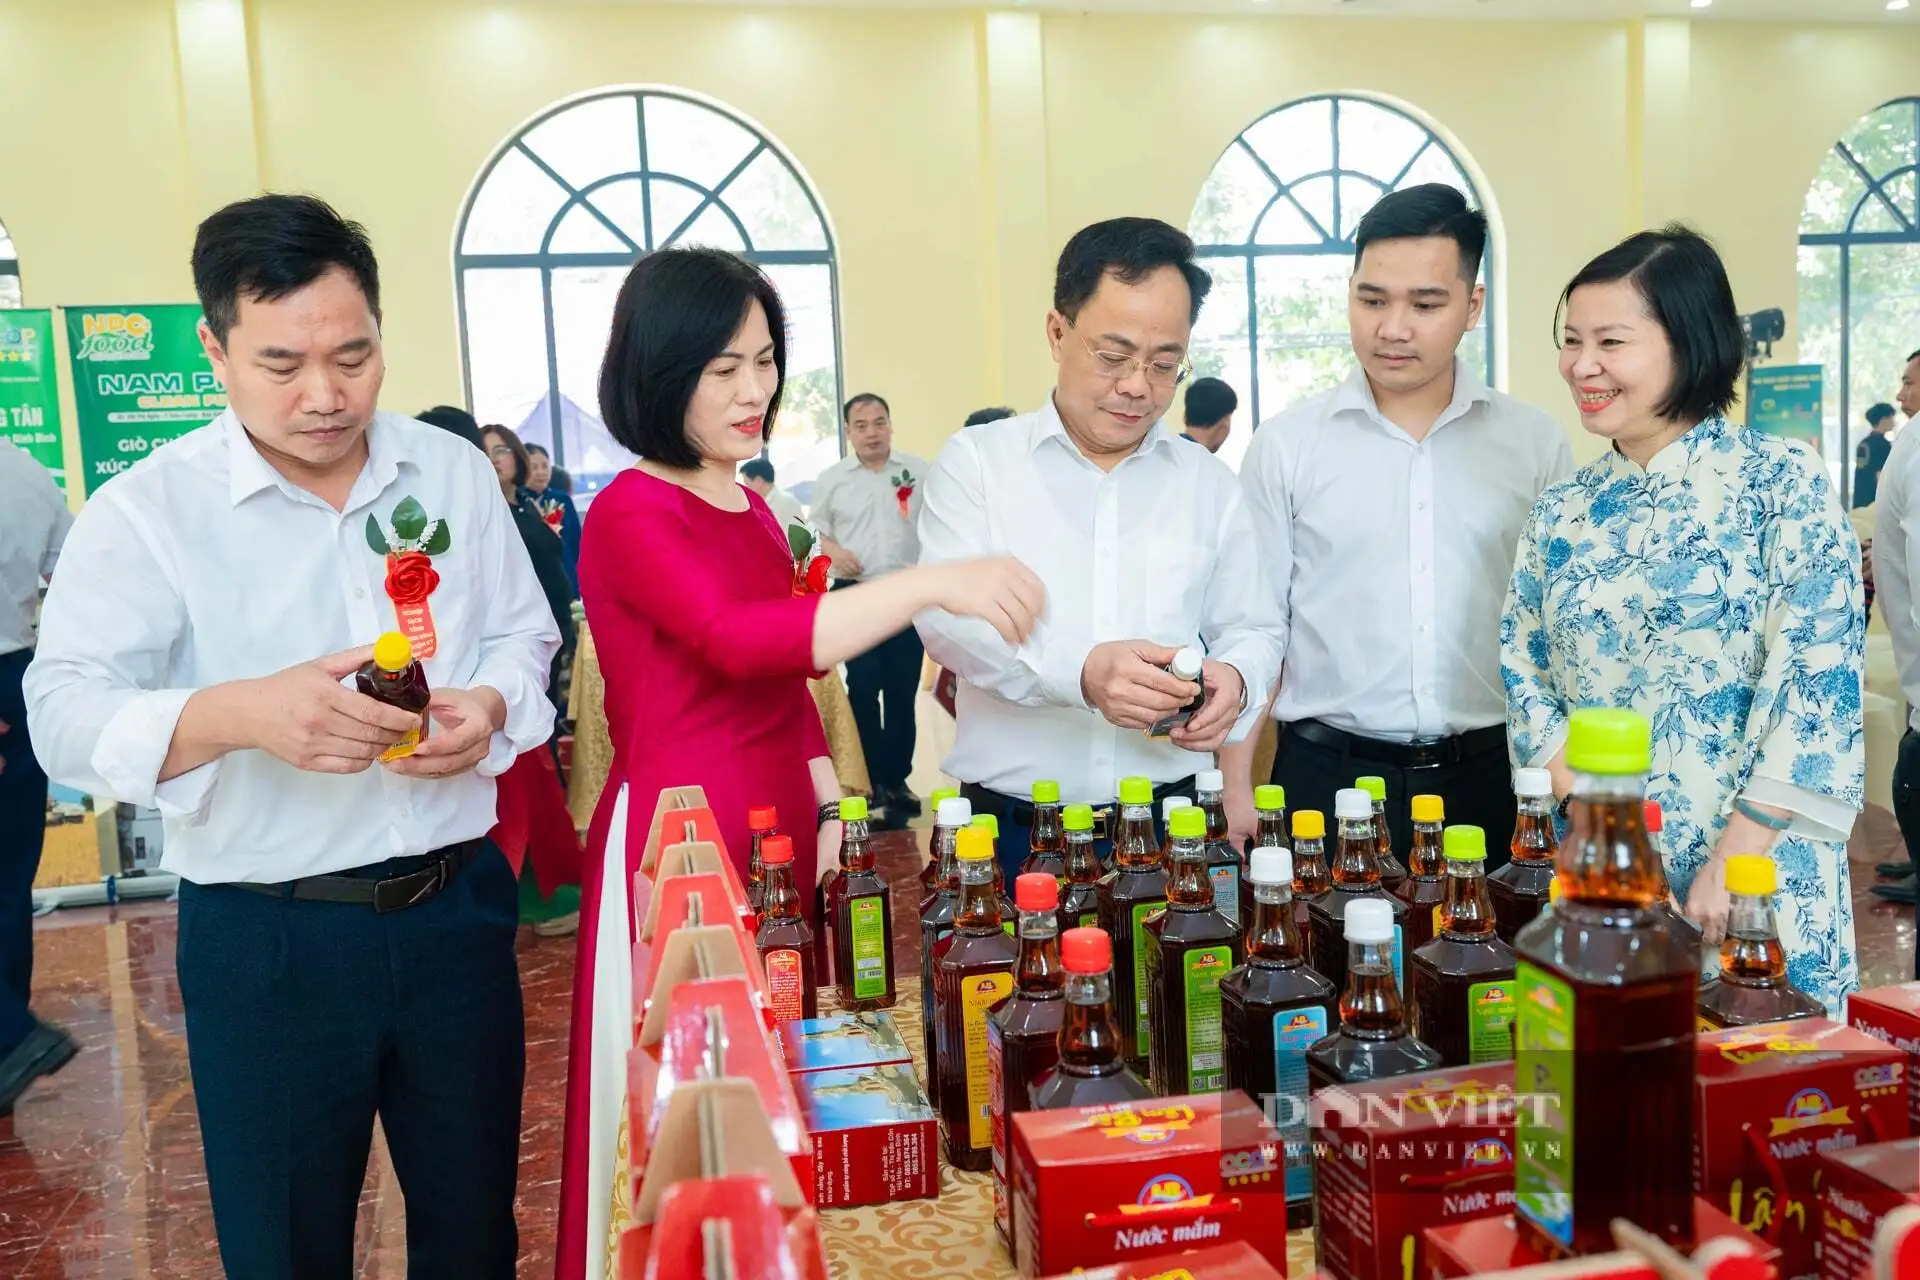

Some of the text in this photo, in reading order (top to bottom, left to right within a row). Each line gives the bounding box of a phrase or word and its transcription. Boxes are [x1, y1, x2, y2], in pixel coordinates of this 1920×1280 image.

[76, 333, 155, 360] food
[98, 372, 184, 395] NAM
[10, 403, 44, 427] TÂN
[117, 436, 149, 453] GIÒ
[1114, 1215, 1222, 1251] Nước mắm
